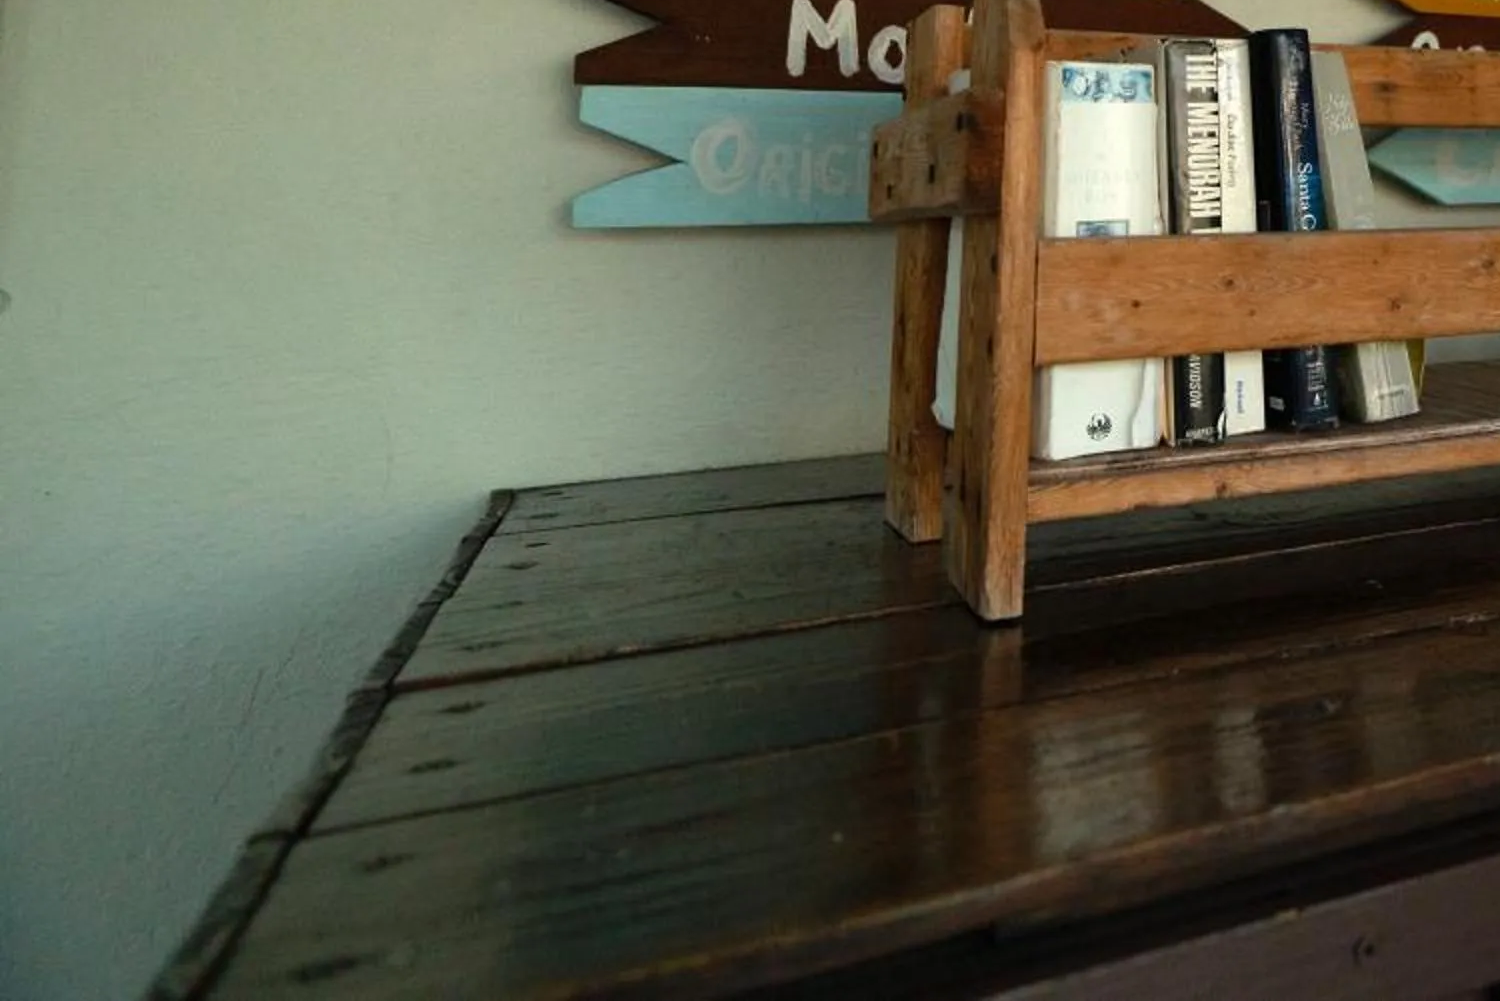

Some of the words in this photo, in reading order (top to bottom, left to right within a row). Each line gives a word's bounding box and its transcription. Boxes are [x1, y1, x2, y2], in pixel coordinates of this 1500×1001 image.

[1185, 54, 1217, 94] THE
[1187, 102, 1221, 218] MENORAH
[1188, 353, 1203, 409] AVIDSON
